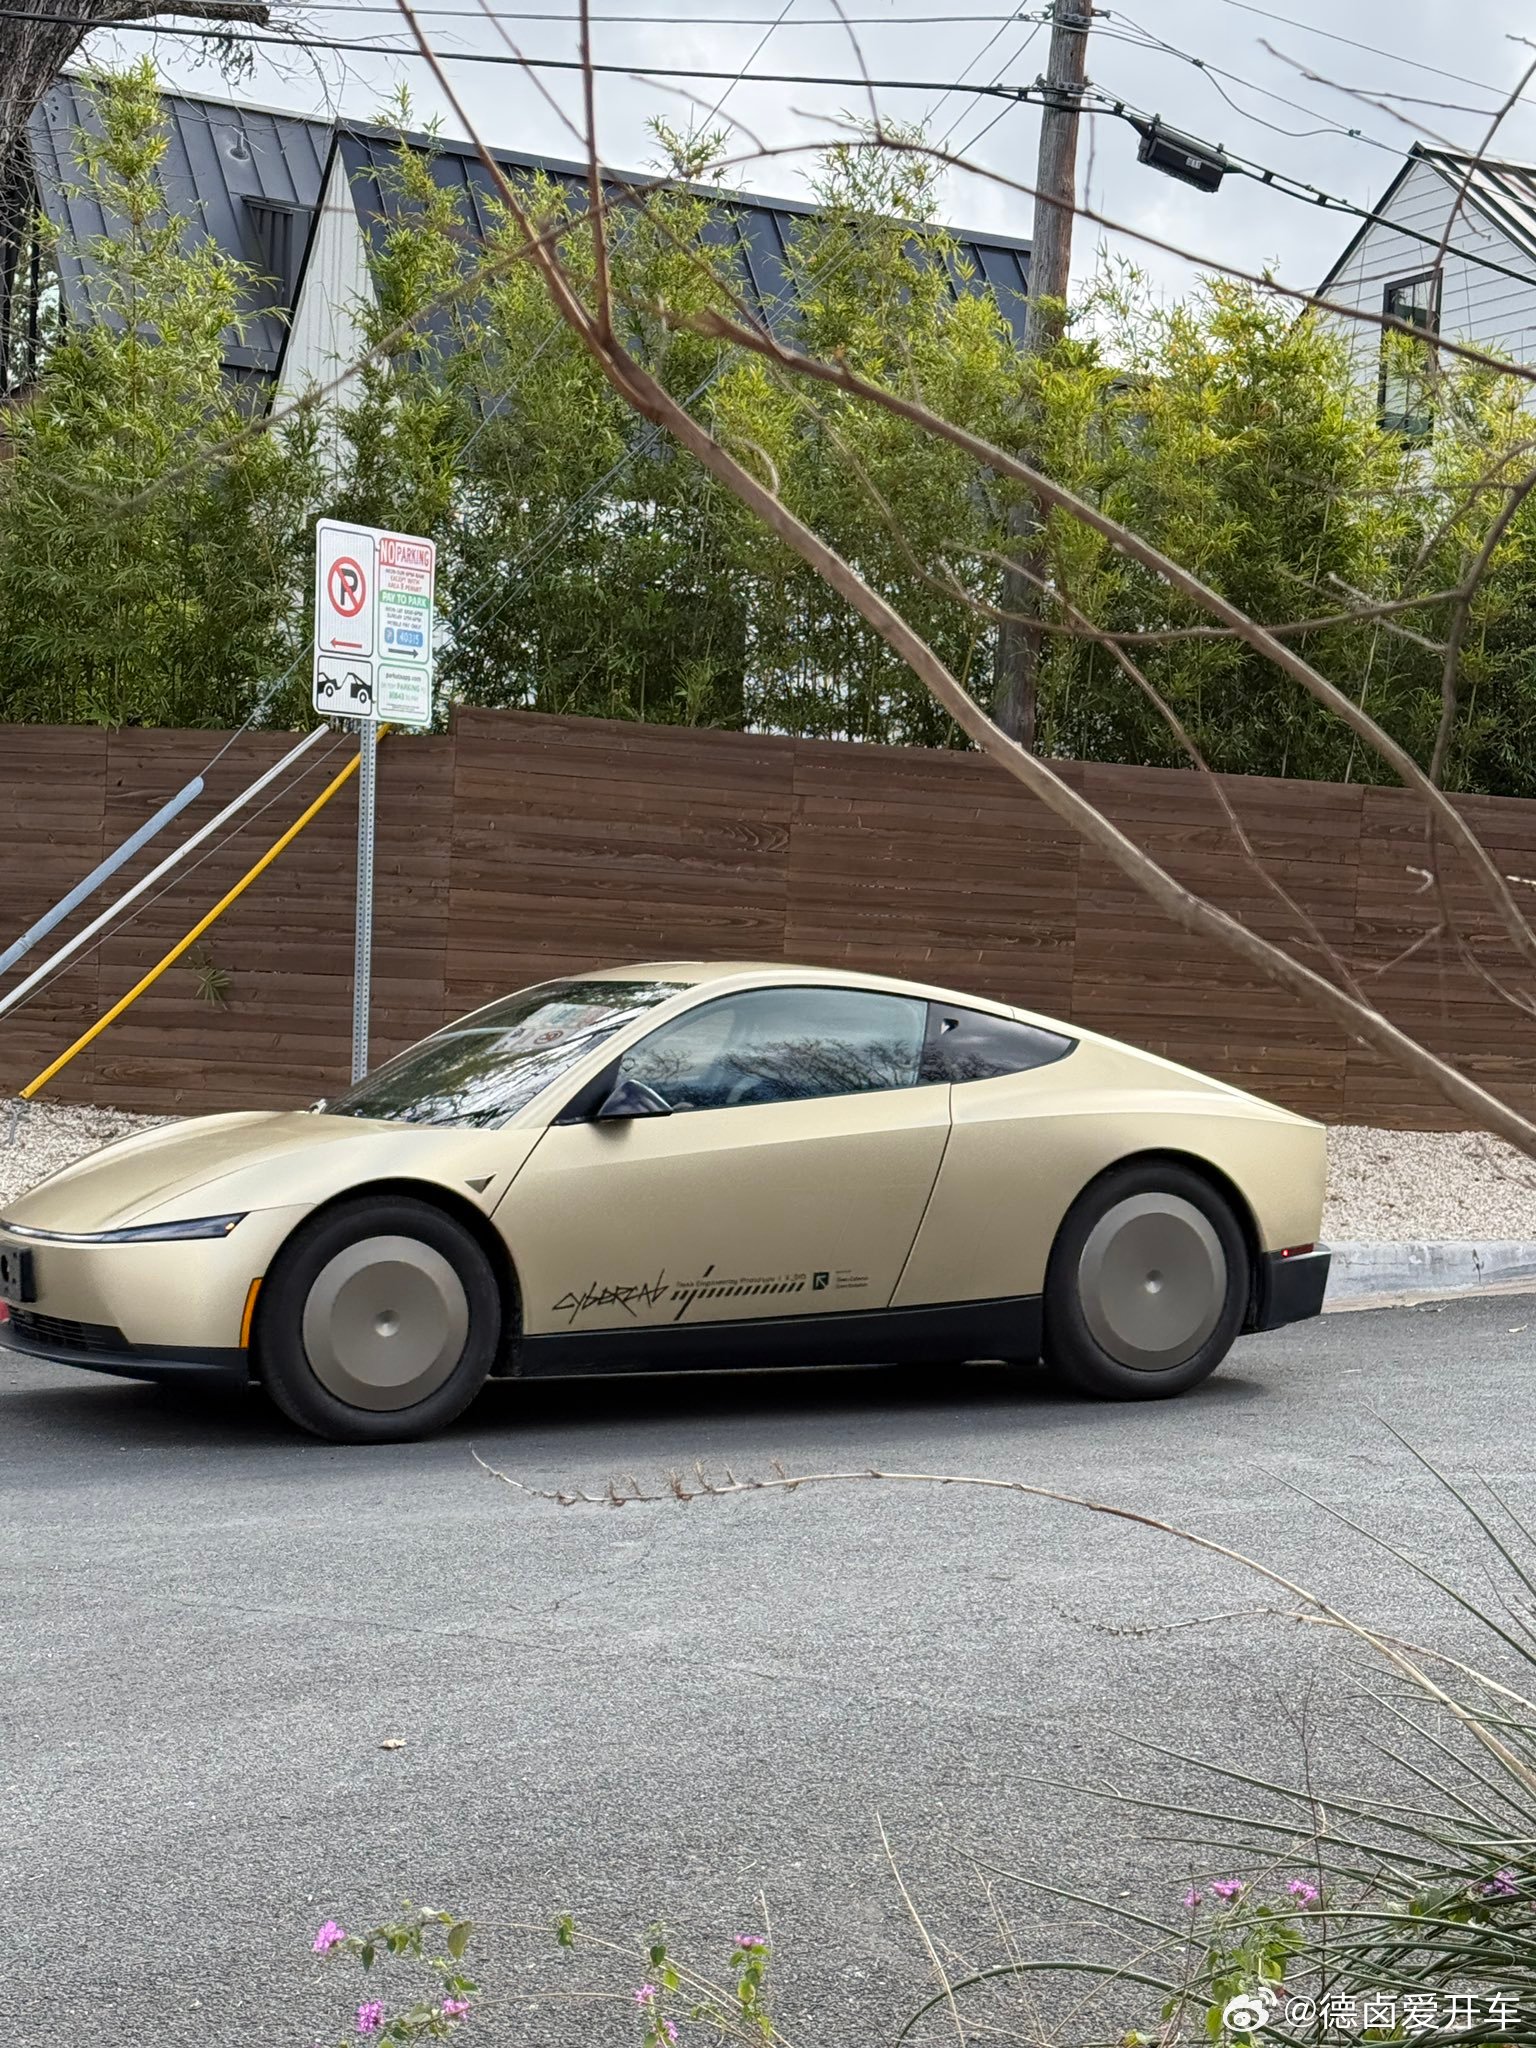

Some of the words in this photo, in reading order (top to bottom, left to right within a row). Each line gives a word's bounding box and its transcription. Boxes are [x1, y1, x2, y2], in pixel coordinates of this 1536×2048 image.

[380, 539, 395, 564] NO
[397, 546, 429, 567] PARKING
[382, 591, 395, 603] PAY
[396, 593, 407, 605] TO
[408, 595, 427, 608] PARK
